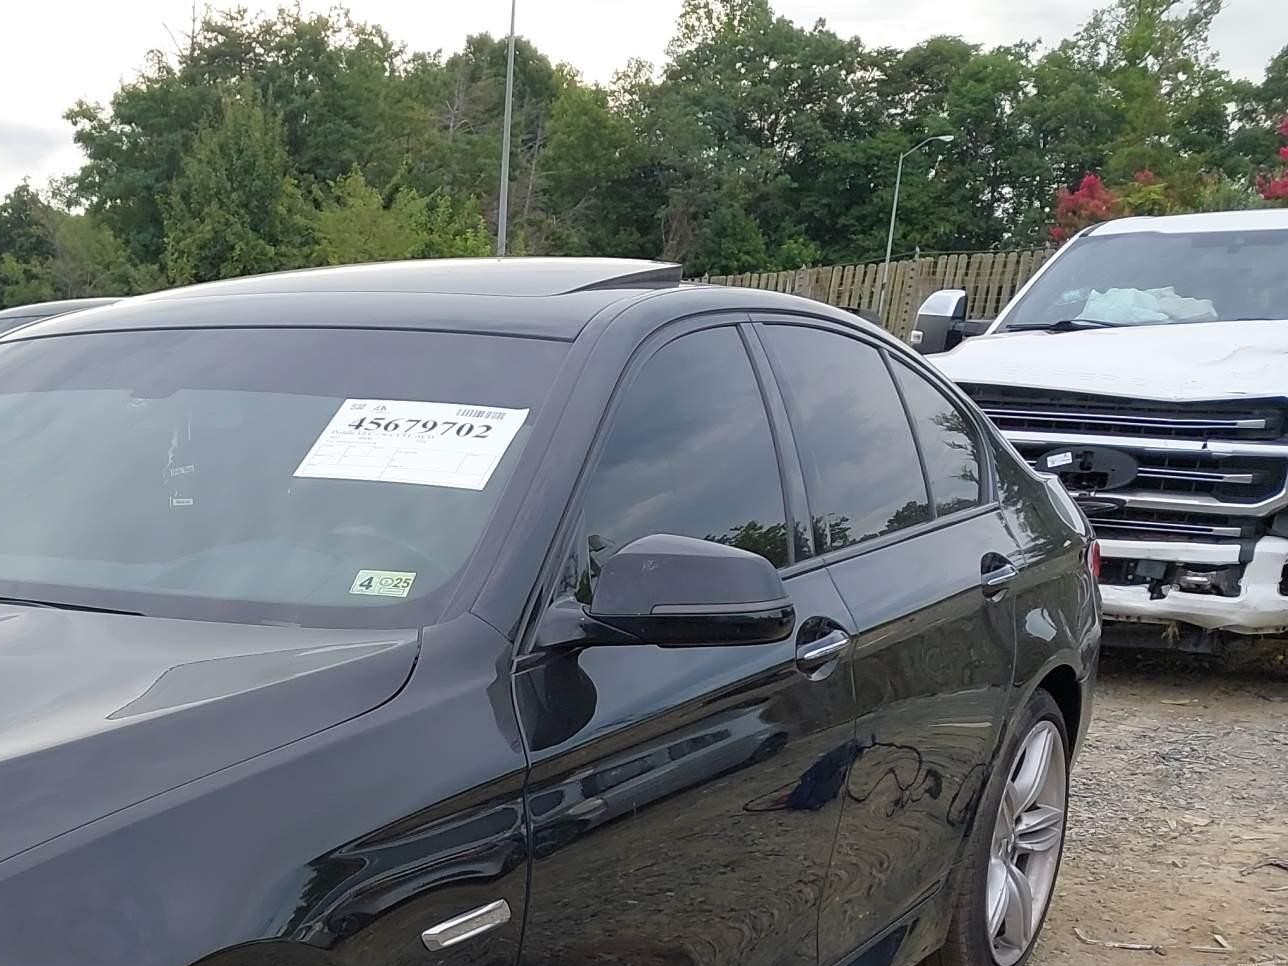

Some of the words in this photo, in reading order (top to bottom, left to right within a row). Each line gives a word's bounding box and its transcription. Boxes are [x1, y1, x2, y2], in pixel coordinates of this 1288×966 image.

[348, 416, 493, 439] 45679702
[359, 576, 374, 591] 4
[392, 577, 411, 589] 25
